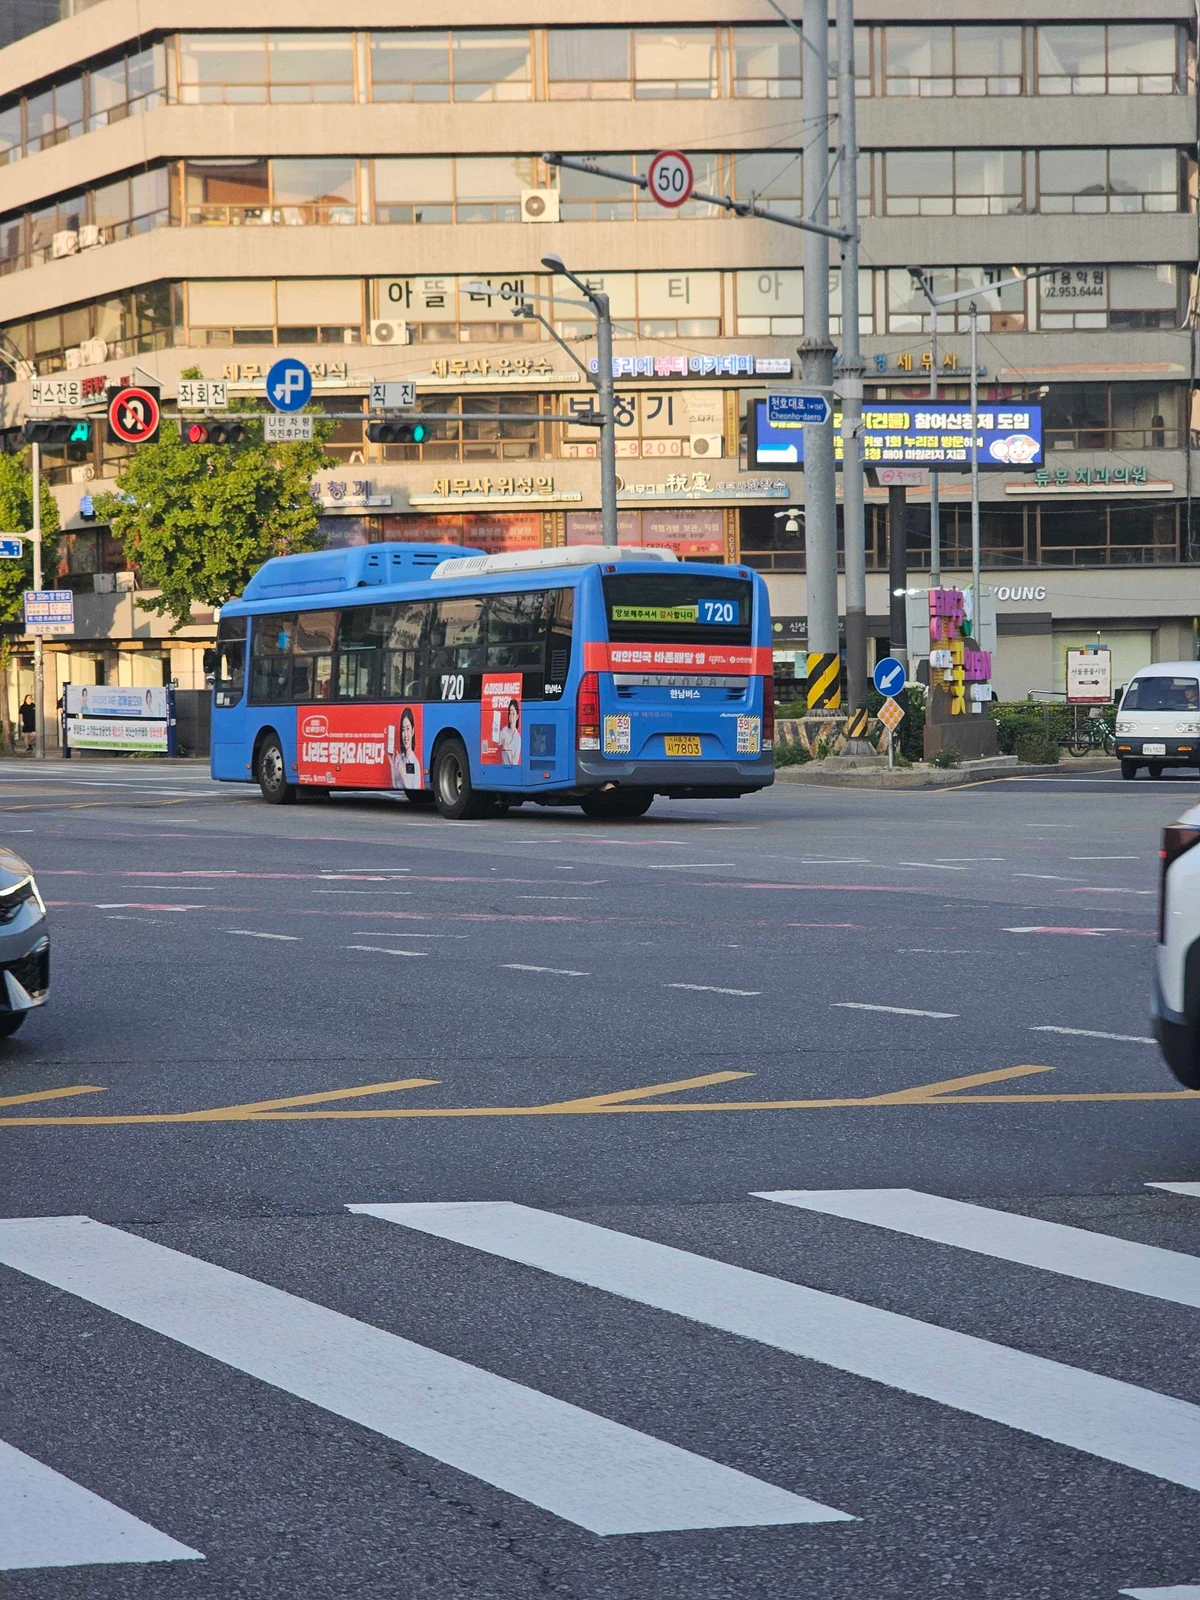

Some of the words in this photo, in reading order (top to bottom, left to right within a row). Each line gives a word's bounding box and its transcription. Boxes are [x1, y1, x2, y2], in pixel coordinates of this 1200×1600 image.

[658, 167, 684, 192] 50
[431, 359, 491, 378] 세무사
[656, 356, 688, 376] 뷰티
[689, 355, 754, 375] 아카데미
[32, 383, 79, 405] 버스전용
[178, 384, 226, 406] 좌회전
[771, 397, 806, 410] 천호대로
[770, 411, 822, 421] Cheonho-daero
[997, 413, 1030, 430] 도입
[268, 428, 311, 438] 직진후P턴
[904, 436, 939, 448] 누리집
[1075, 467, 1148, 486] 치과의원
[433, 478, 492, 498] 세무사
[498, 476, 555, 497] 위성일
[615, 609, 657, 619] 양보해주셔서
[659, 610, 694, 619] 감사합니다
[704, 602, 734, 622] 720
[611, 650, 652, 664] 대한민국
[441, 674, 465, 700] 720
[642, 675, 728, 687] HYUNDAI
[669, 689, 701, 699] 한남버스
[617, 718, 630, 730] 주의
[738, 718, 750, 730] 주의
